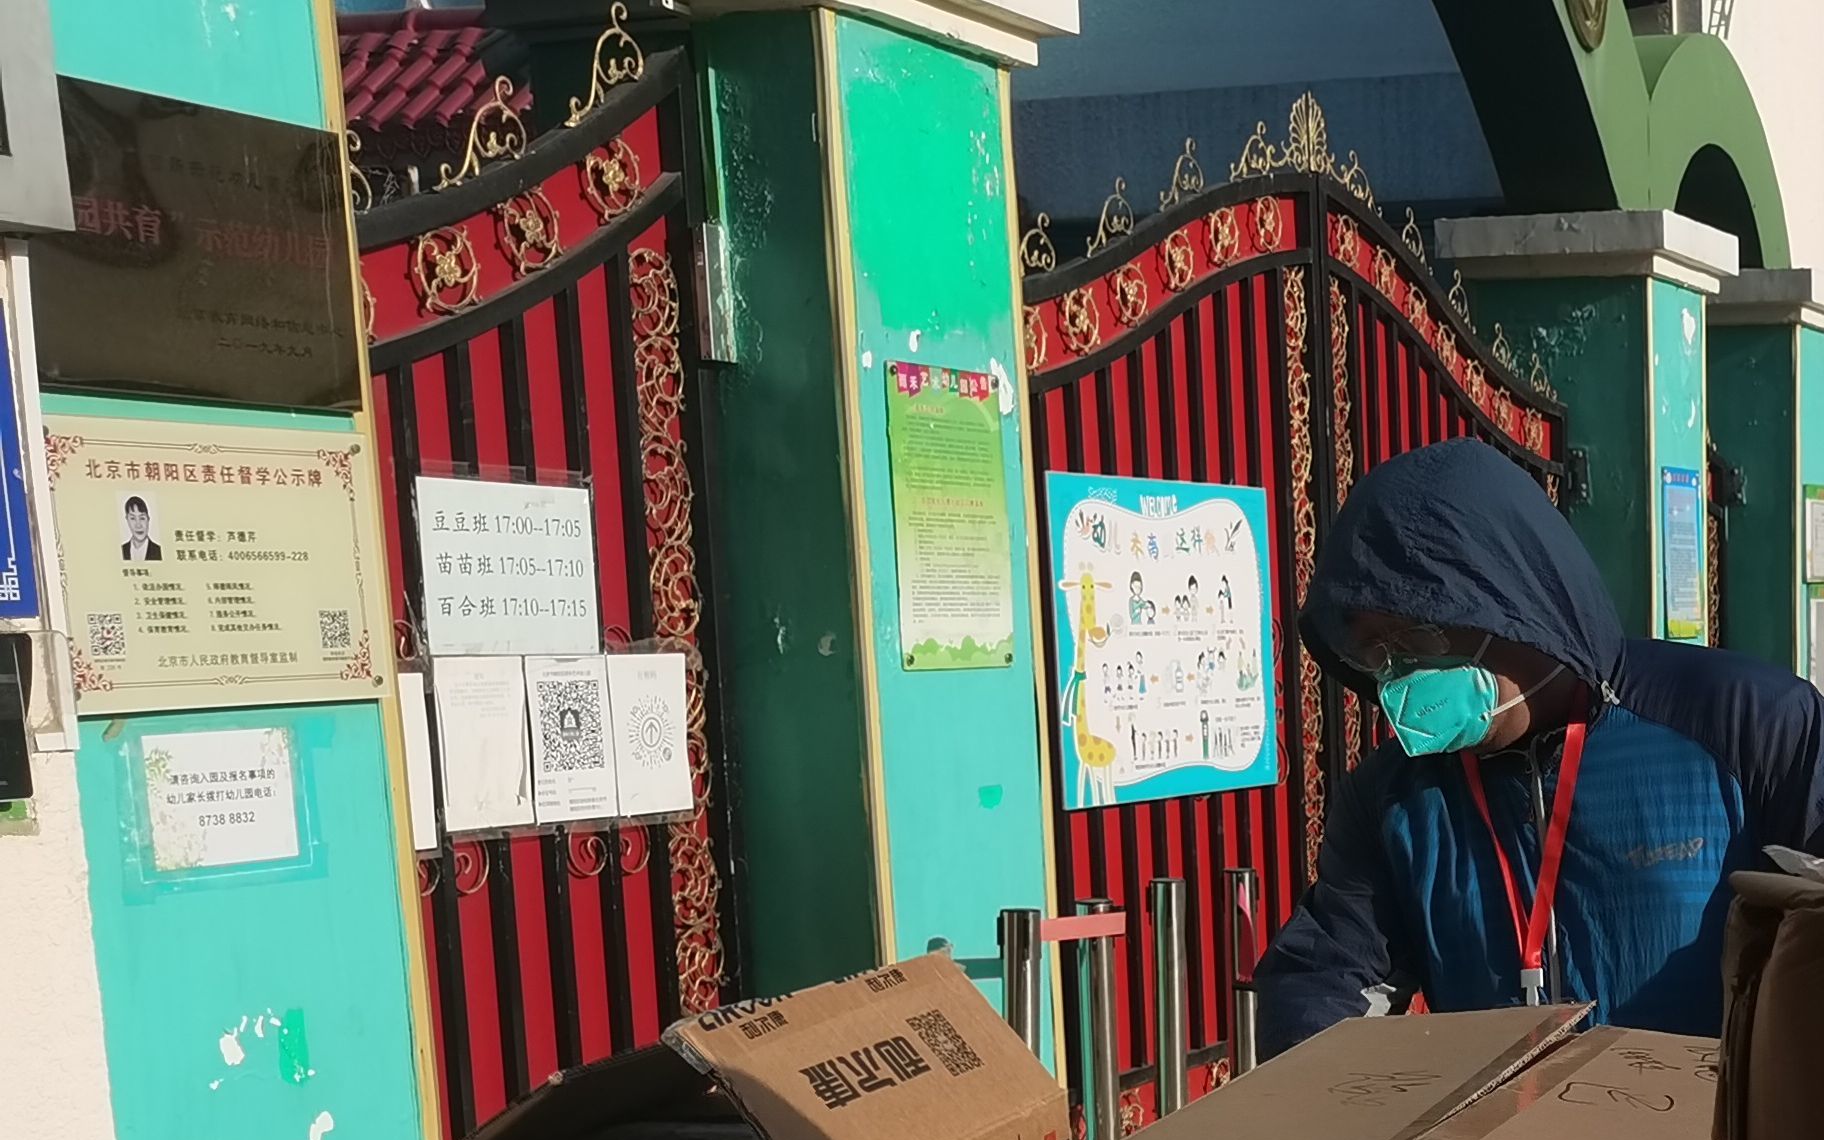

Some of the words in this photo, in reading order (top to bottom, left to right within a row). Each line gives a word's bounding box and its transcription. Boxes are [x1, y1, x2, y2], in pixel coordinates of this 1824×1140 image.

[85, 458, 323, 487] 北京市朝阳区责任督学公示牌
[432, 511, 490, 533] 豆豆班
[494, 516, 582, 538] 17:00--17:05
[436, 554, 494, 576] 苗苗班
[499, 557, 584, 578] 17:05--17:10
[438, 596, 496, 618] 百合班
[502, 598, 588, 618] 17:10--17:15
[199, 813, 226, 827] 8738
[229, 811, 256, 825] 8832
